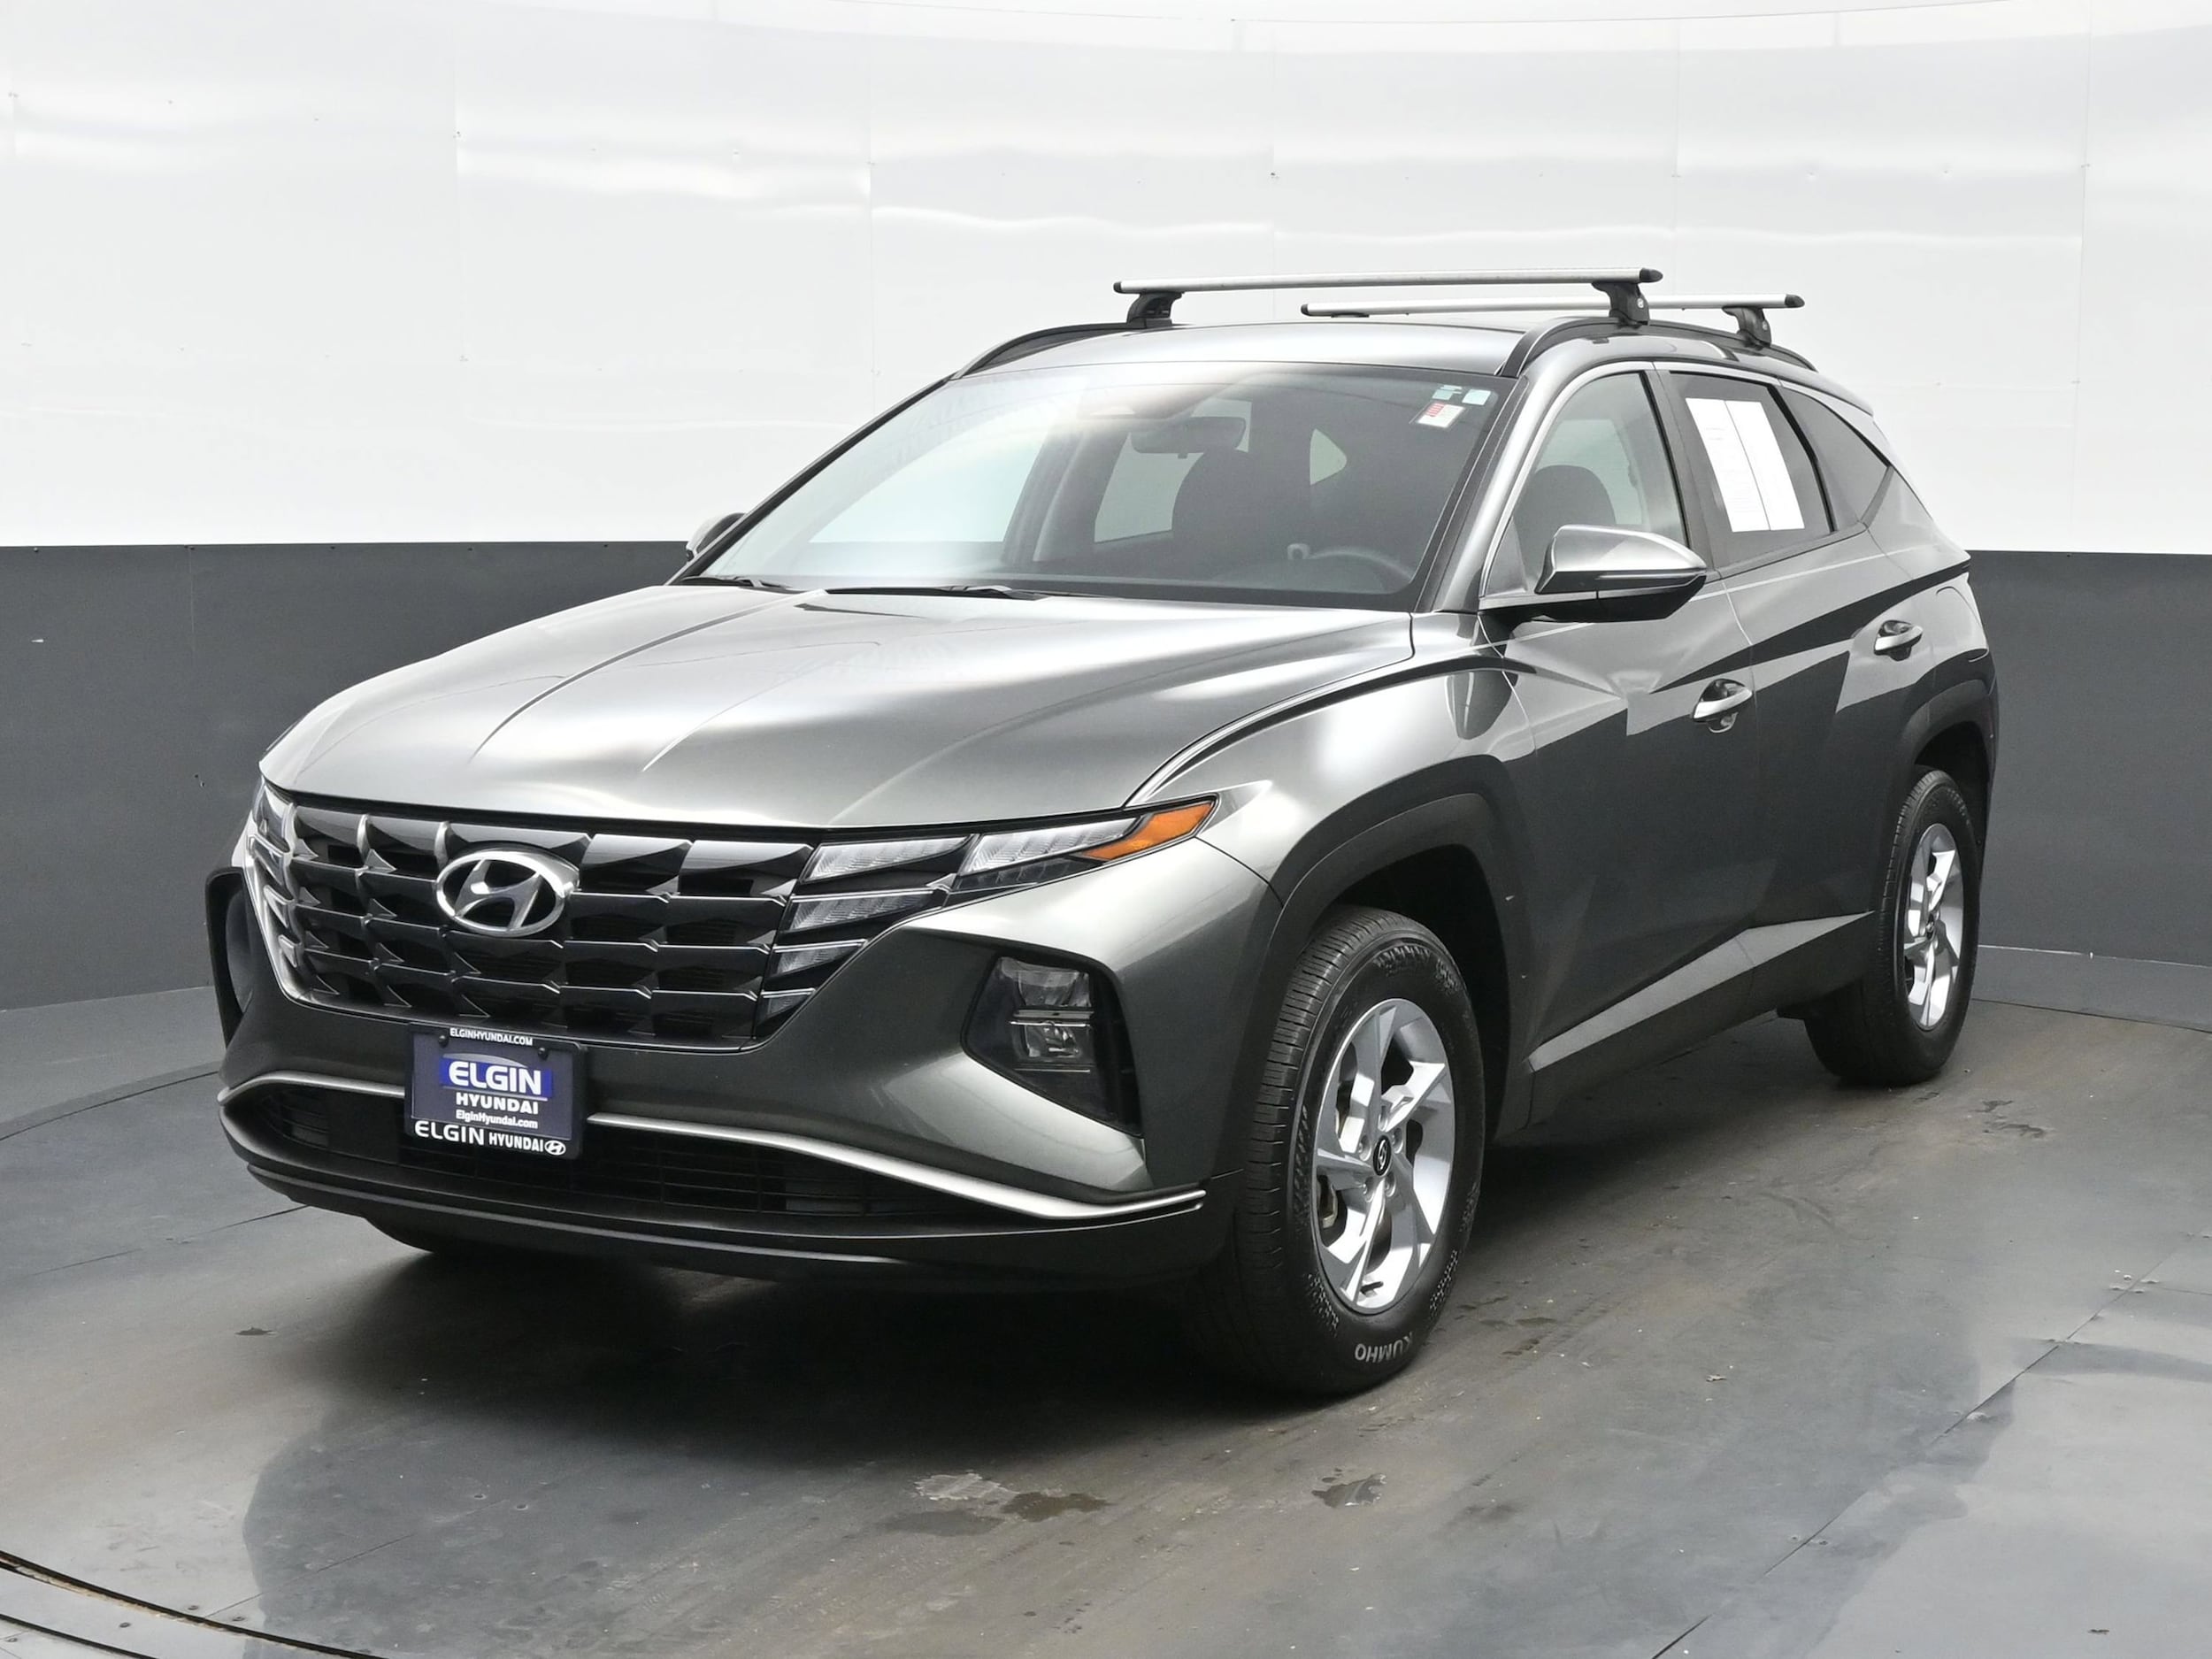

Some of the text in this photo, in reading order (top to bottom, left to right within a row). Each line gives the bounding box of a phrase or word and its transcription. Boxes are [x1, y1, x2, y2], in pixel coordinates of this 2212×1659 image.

[449, 1027, 533, 1046] ELGINHYUNDAI.COM
[449, 1061, 541, 1094] ELGIN
[456, 1092, 539, 1114] HYUNDAI
[456, 1109, 538, 1129] ElginHyundai.com
[414, 1120, 543, 1152] ELGIN HYUNDAI
[1355, 1331, 1413, 1363] KUMHO
